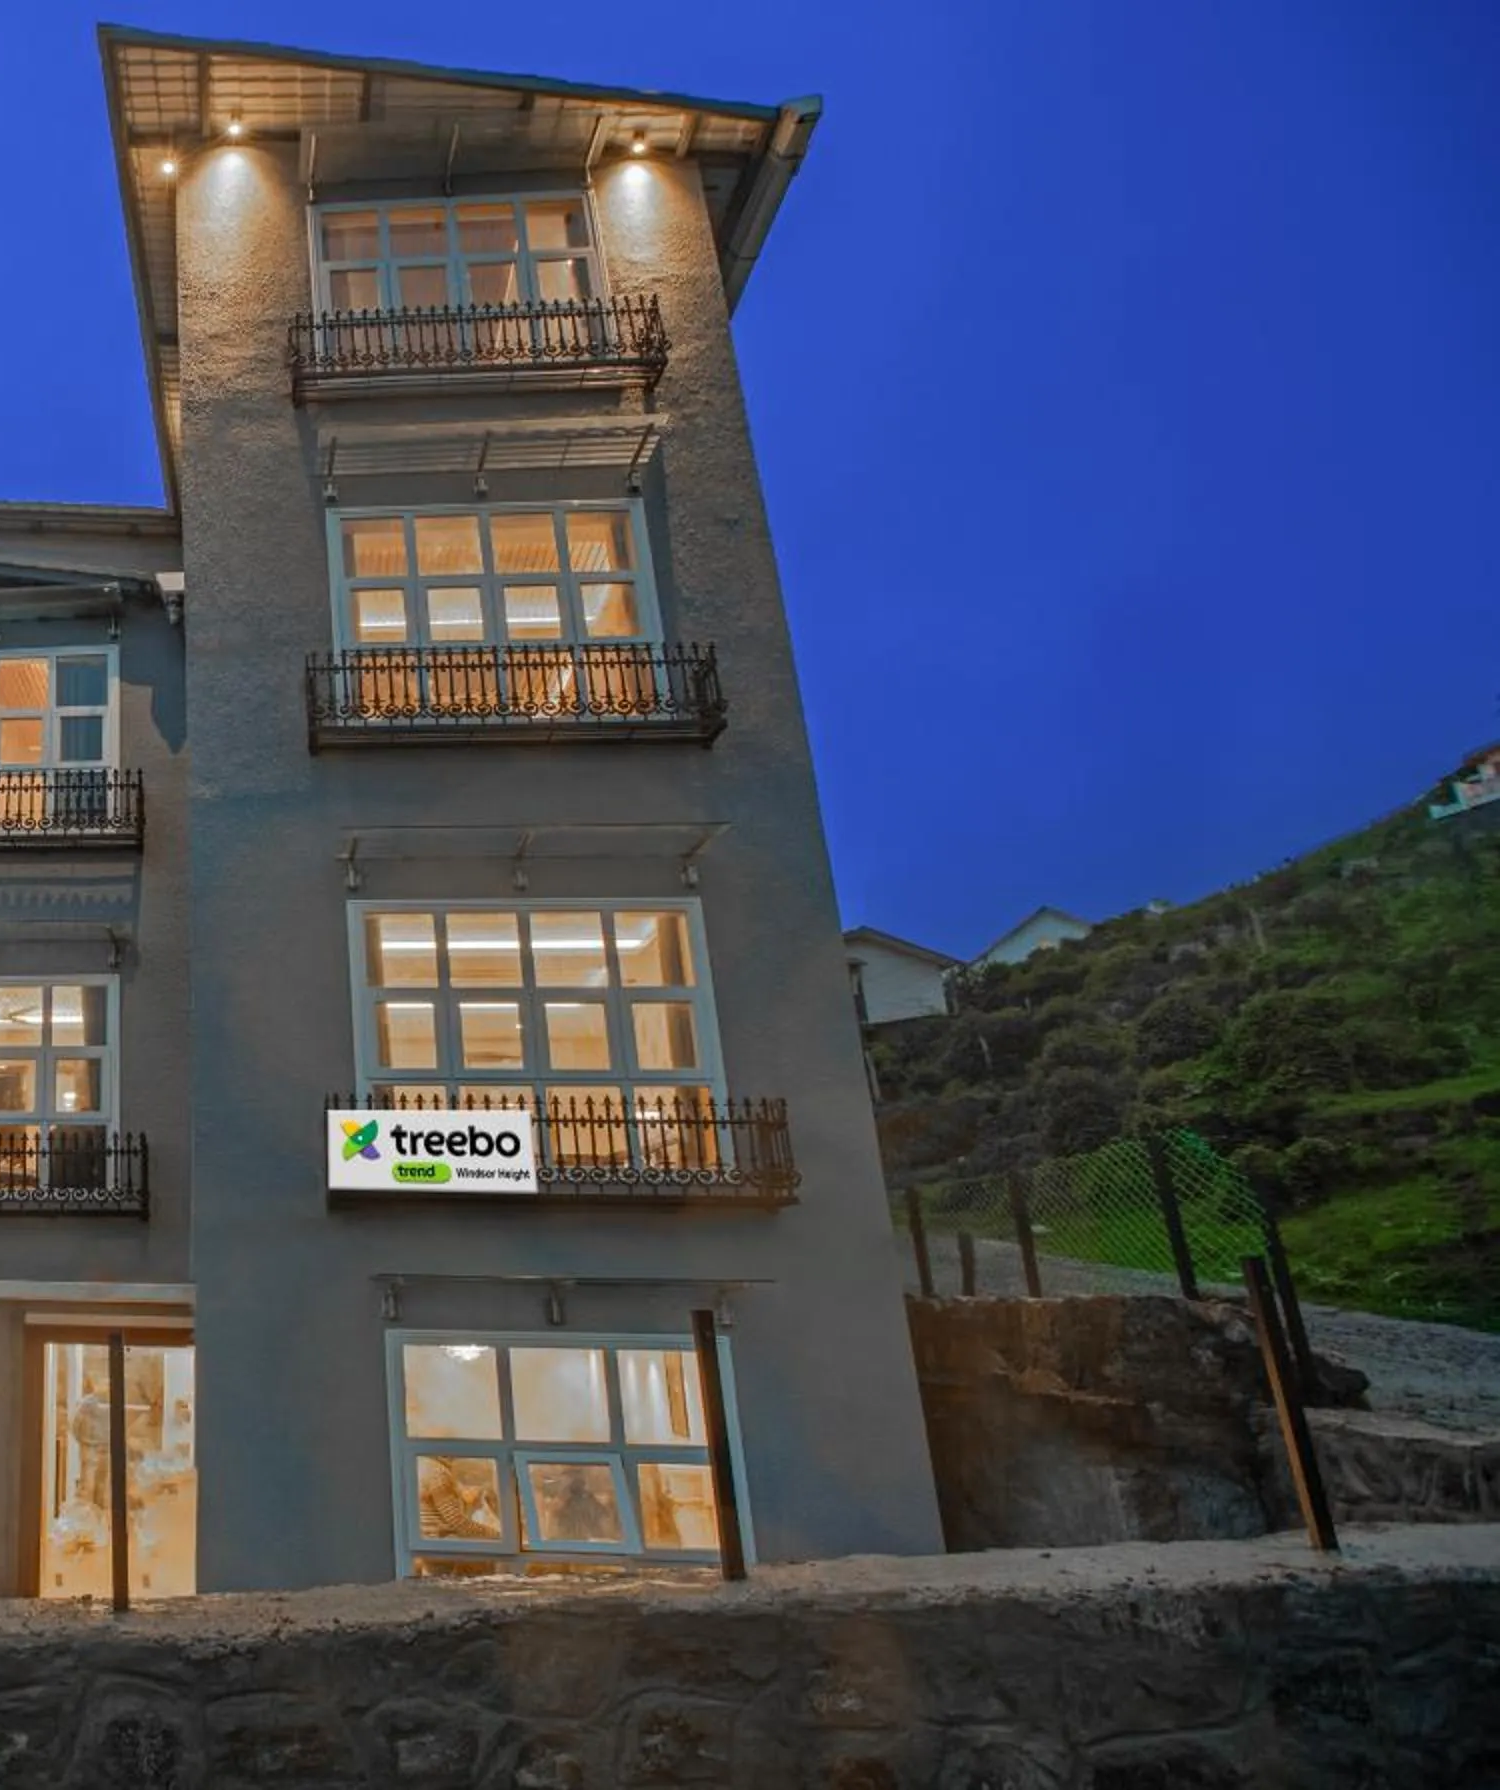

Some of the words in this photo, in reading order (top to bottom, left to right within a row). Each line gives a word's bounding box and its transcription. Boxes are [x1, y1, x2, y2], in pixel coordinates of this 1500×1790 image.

[390, 1125, 521, 1158] treebo
[398, 1165, 436, 1178] trend
[455, 1167, 496, 1179] Windsor
[497, 1168, 531, 1182] Height
